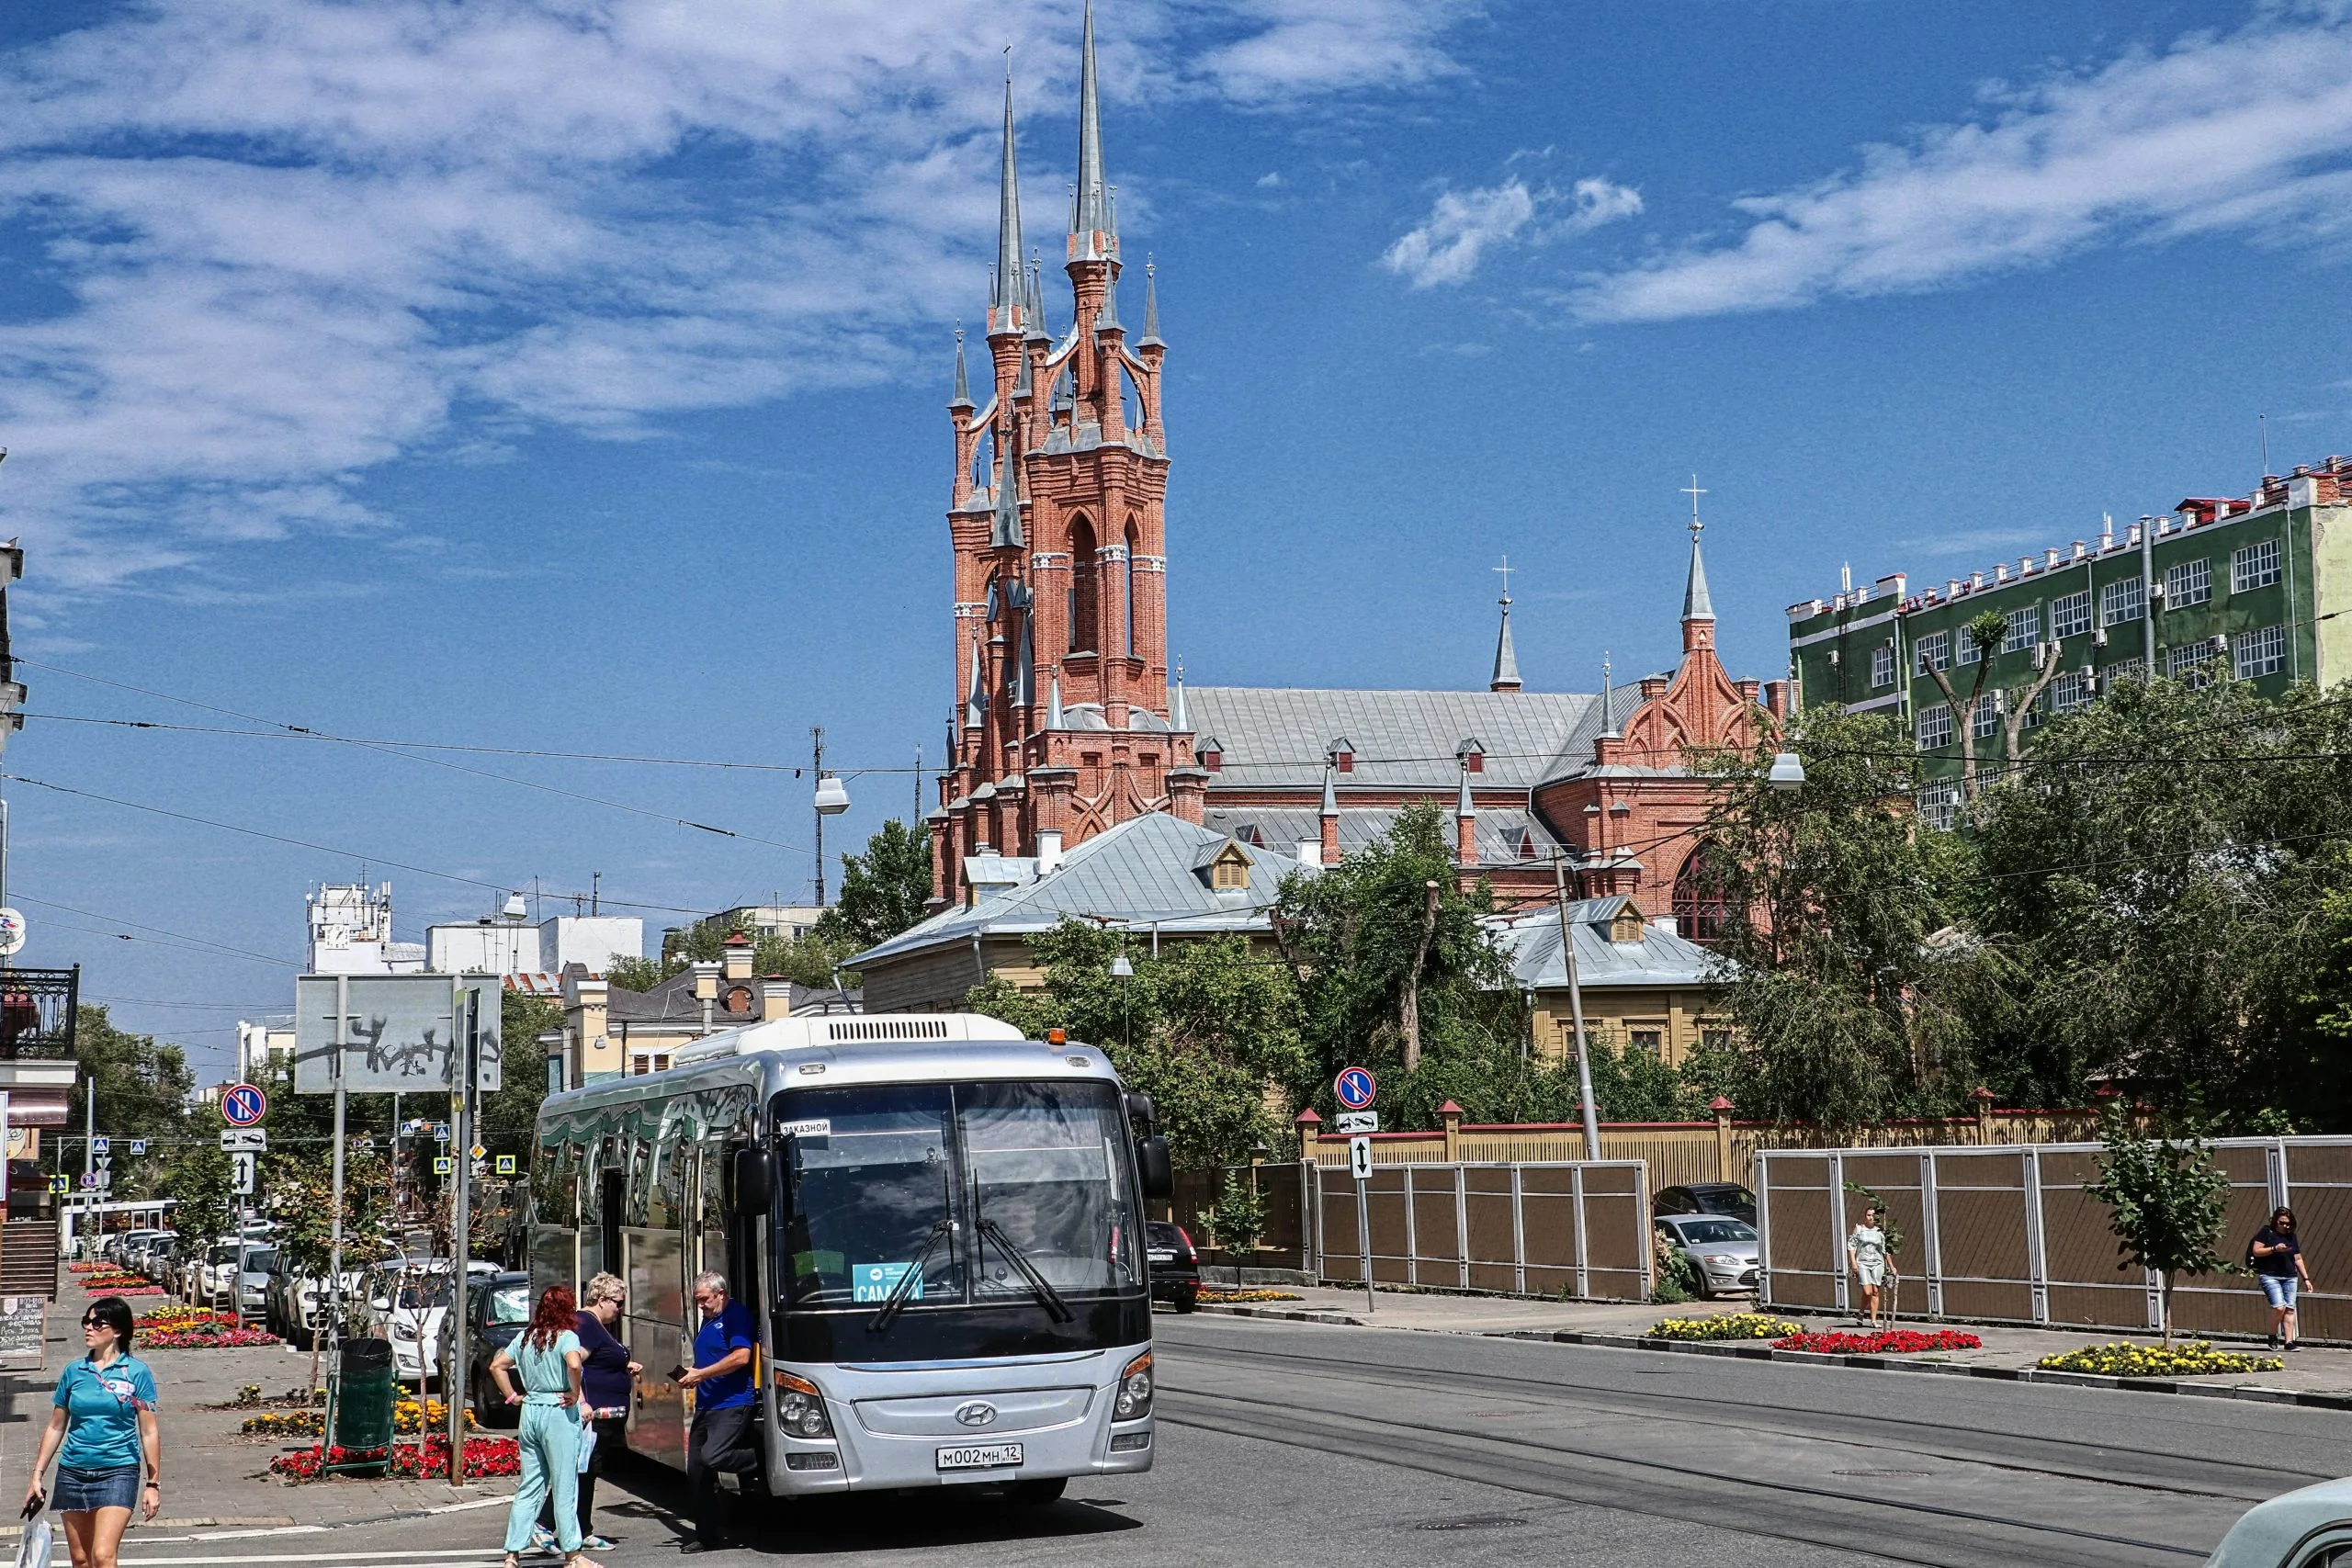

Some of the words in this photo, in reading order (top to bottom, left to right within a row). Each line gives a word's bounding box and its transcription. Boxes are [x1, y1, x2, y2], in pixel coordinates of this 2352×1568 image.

[783, 1122, 828, 1135] ЗАКАЗНОЙ
[857, 1284, 920, 1303] САМА
[944, 1450, 1000, 1465] М002МН
[1004, 1446, 1017, 1457] 12
